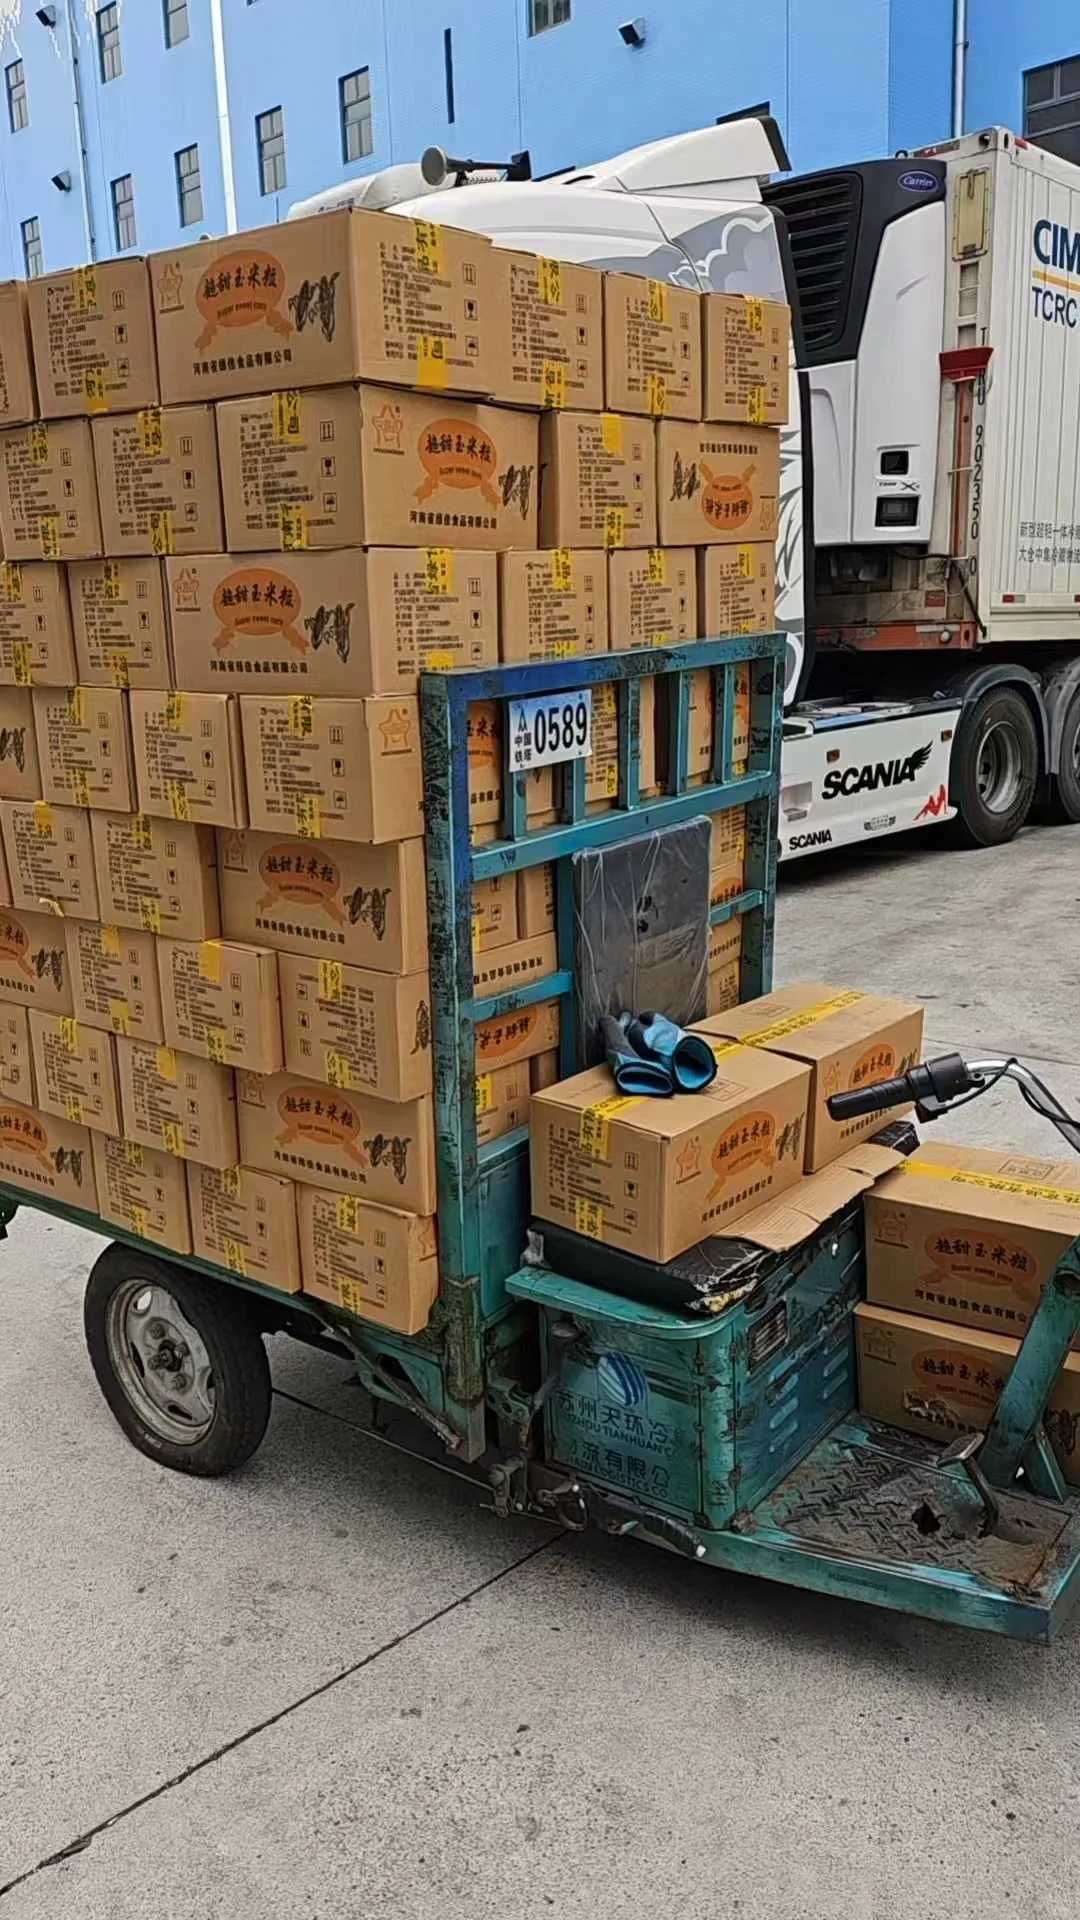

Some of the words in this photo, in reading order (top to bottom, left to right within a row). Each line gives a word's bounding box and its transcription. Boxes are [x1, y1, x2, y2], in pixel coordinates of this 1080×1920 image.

[903, 176, 934, 186] Carrier
[1033, 219, 1080, 275] CIM
[1032, 286, 1078, 329] TCRC
[977, 327, 988, 406] TRU
[970, 424, 984, 540] 902350
[514, 732, 532, 748] 中国
[534, 702, 587, 755] 0589
[514, 749, 532, 764] 铁塔
[821, 757, 916, 800] SCANIA
[788, 828, 832, 851] SCANIA
[475, 1016, 532, 1050] 超甜玉米
[934, 1237, 1029, 1272] 超甜玉米粒
[914, 1289, 1031, 1324] 河南省绿佳食品有限公
[603, 1427, 662, 1454] TIANHUAN
[594, 1467, 650, 1493] LOGISTICS
[651, 1485, 668, 1498] CO
